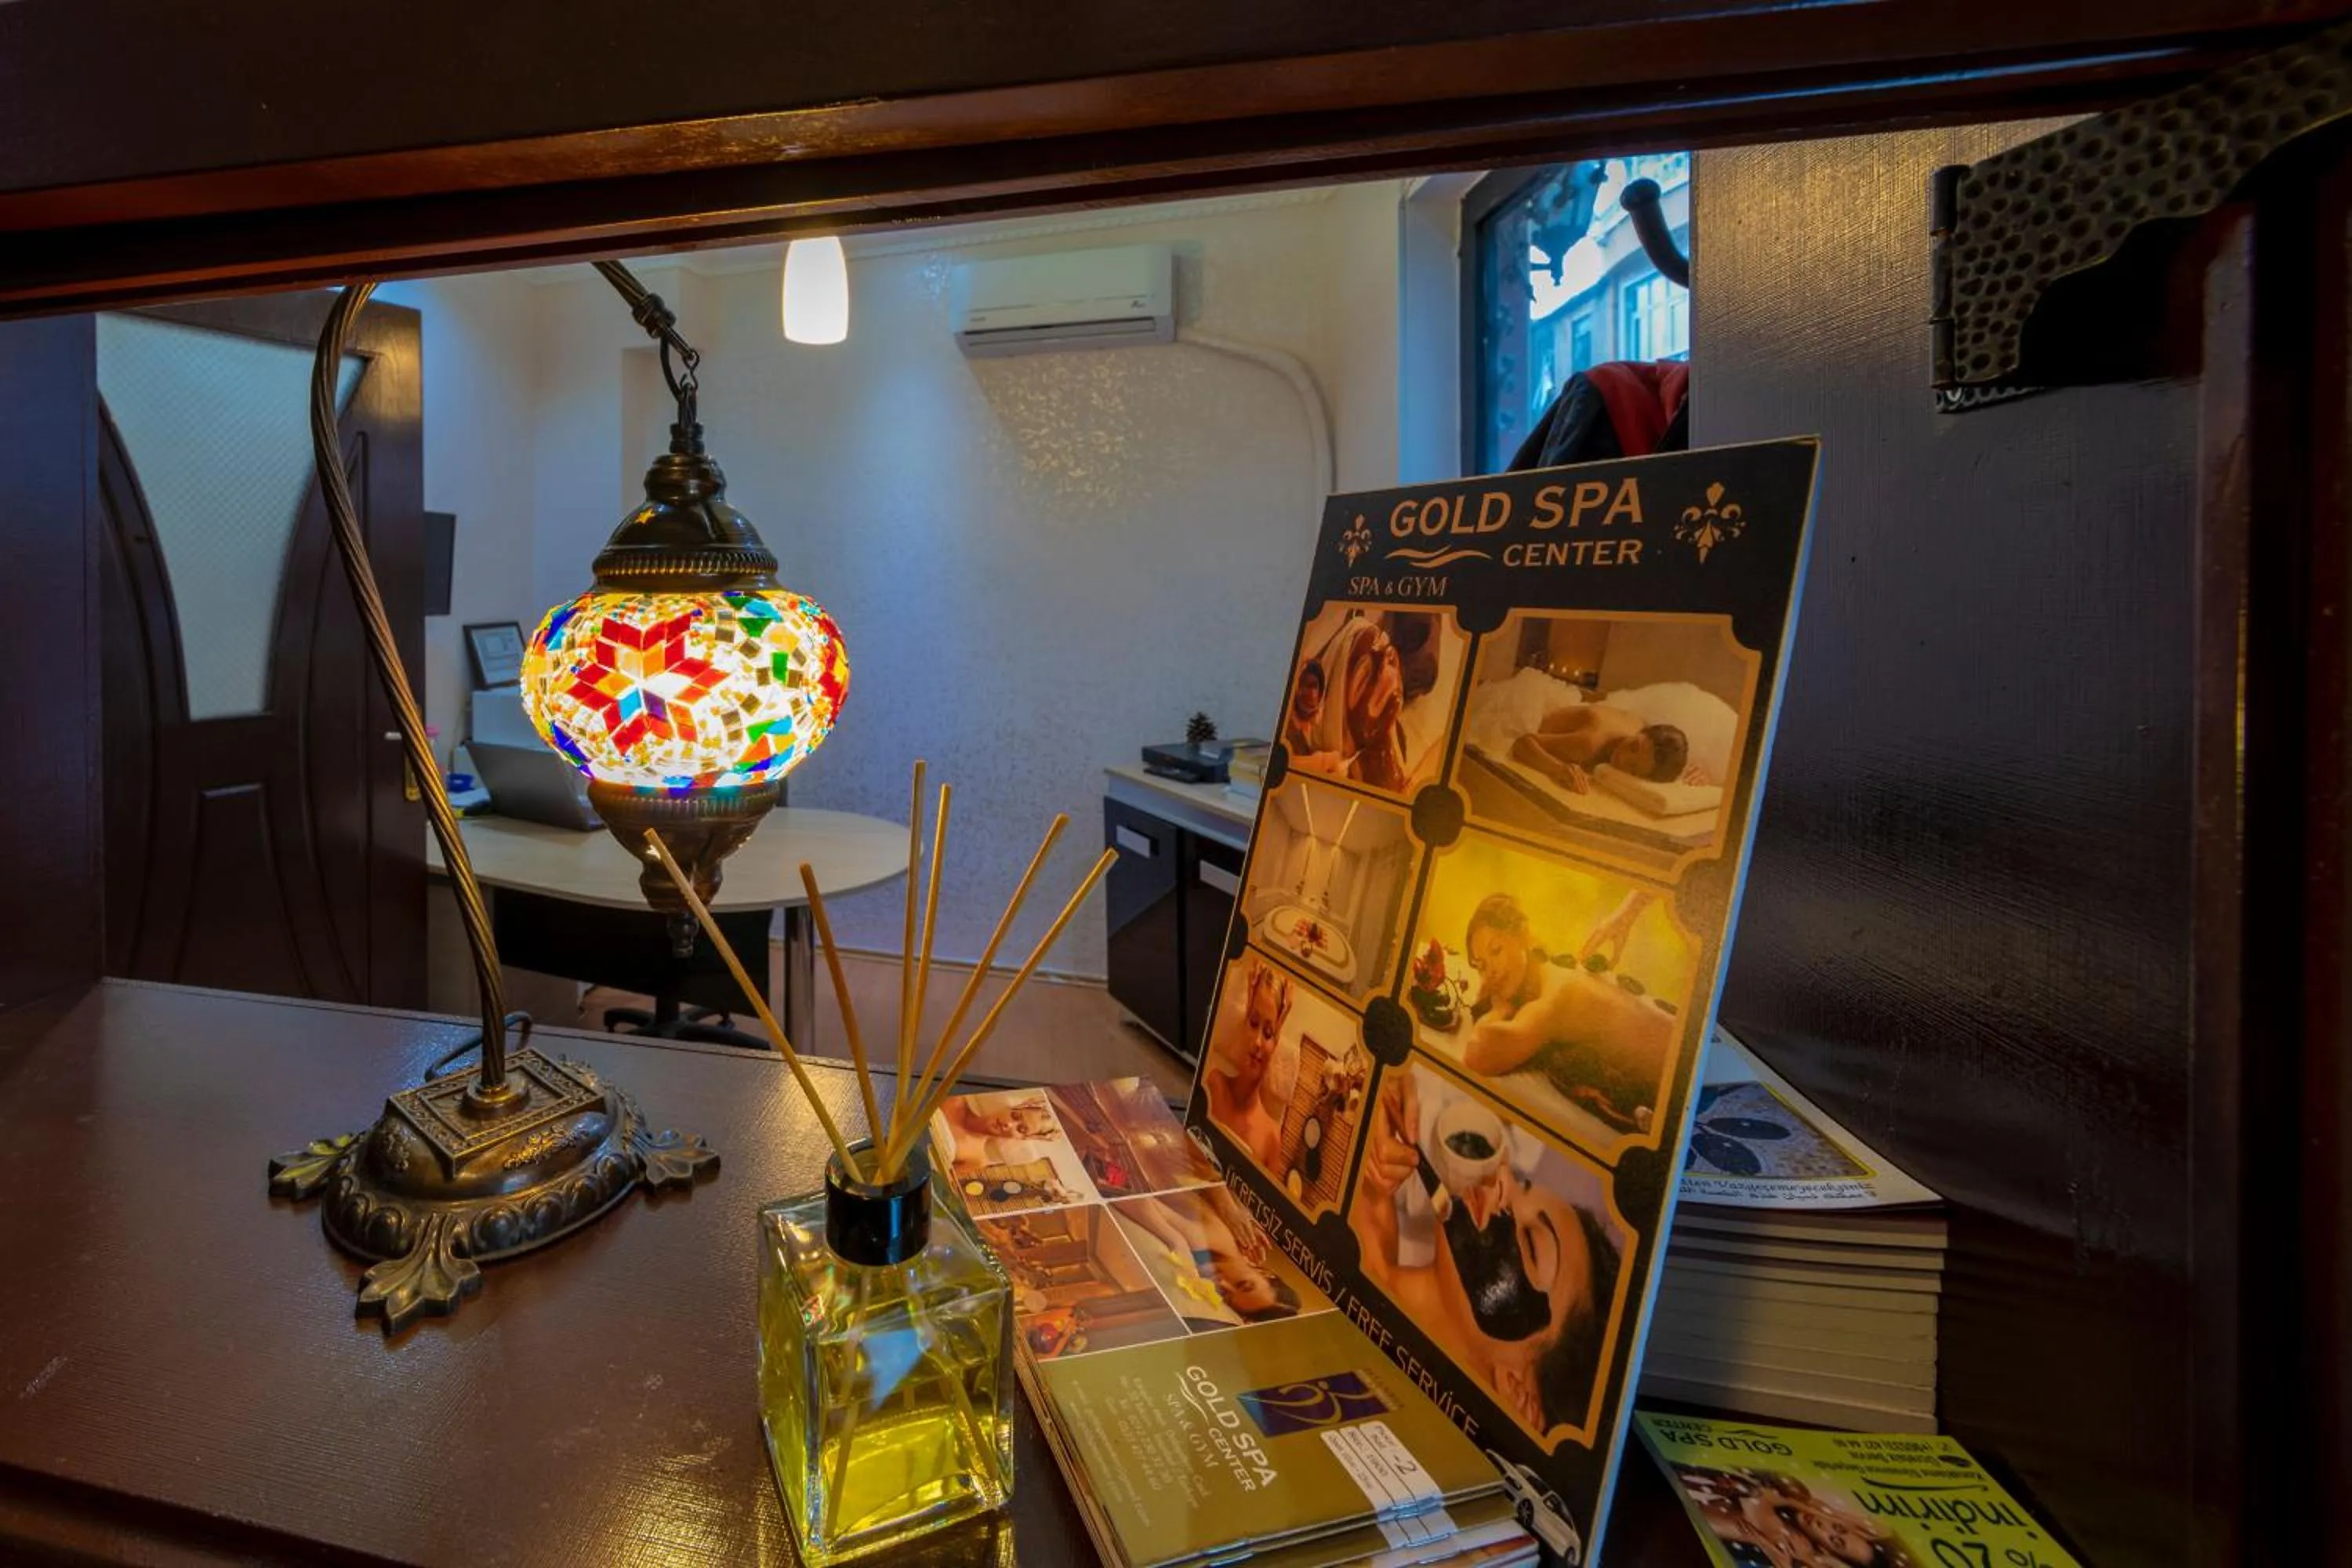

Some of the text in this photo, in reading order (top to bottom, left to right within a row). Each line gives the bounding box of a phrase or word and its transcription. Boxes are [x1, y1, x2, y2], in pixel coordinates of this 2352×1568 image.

[1390, 477, 1643, 537] GOLD SPA
[1503, 540, 1642, 567] CENTER
[1348, 576, 1448, 597] SPA & GYM
[1186, 1366, 1277, 1486] GOLD SPA
[1660, 1429, 1792, 1456] GOLD SPA
[1208, 1428, 1256, 1492] CENTER
[1851, 1490, 2038, 1539] indirim
